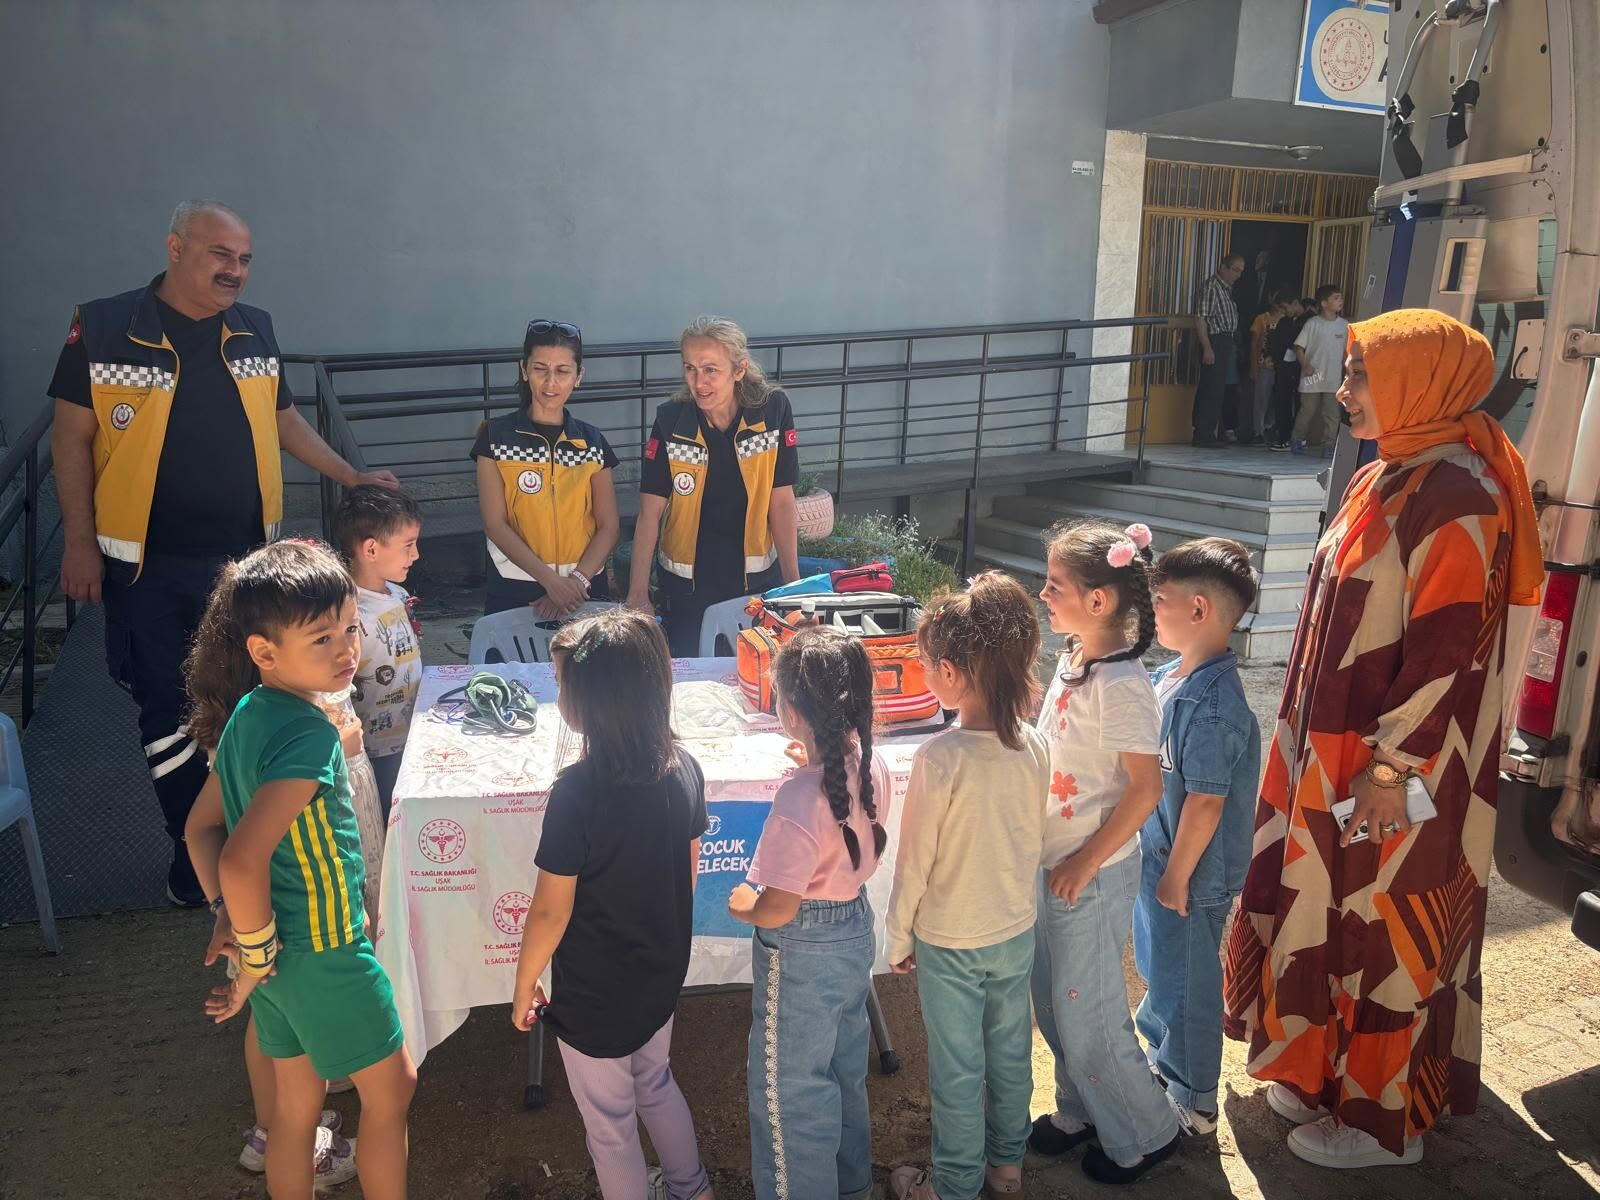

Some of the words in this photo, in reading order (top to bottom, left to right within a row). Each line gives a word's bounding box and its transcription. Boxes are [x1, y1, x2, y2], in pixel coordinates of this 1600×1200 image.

[699, 838, 746, 855] OCUK
[697, 857, 750, 873] ELECEK
[443, 868, 477, 876] BAKANLIĞI
[438, 884, 476, 892] MÜDÜRLÜĞÜ
[495, 942, 518, 950] SAĞLIK
